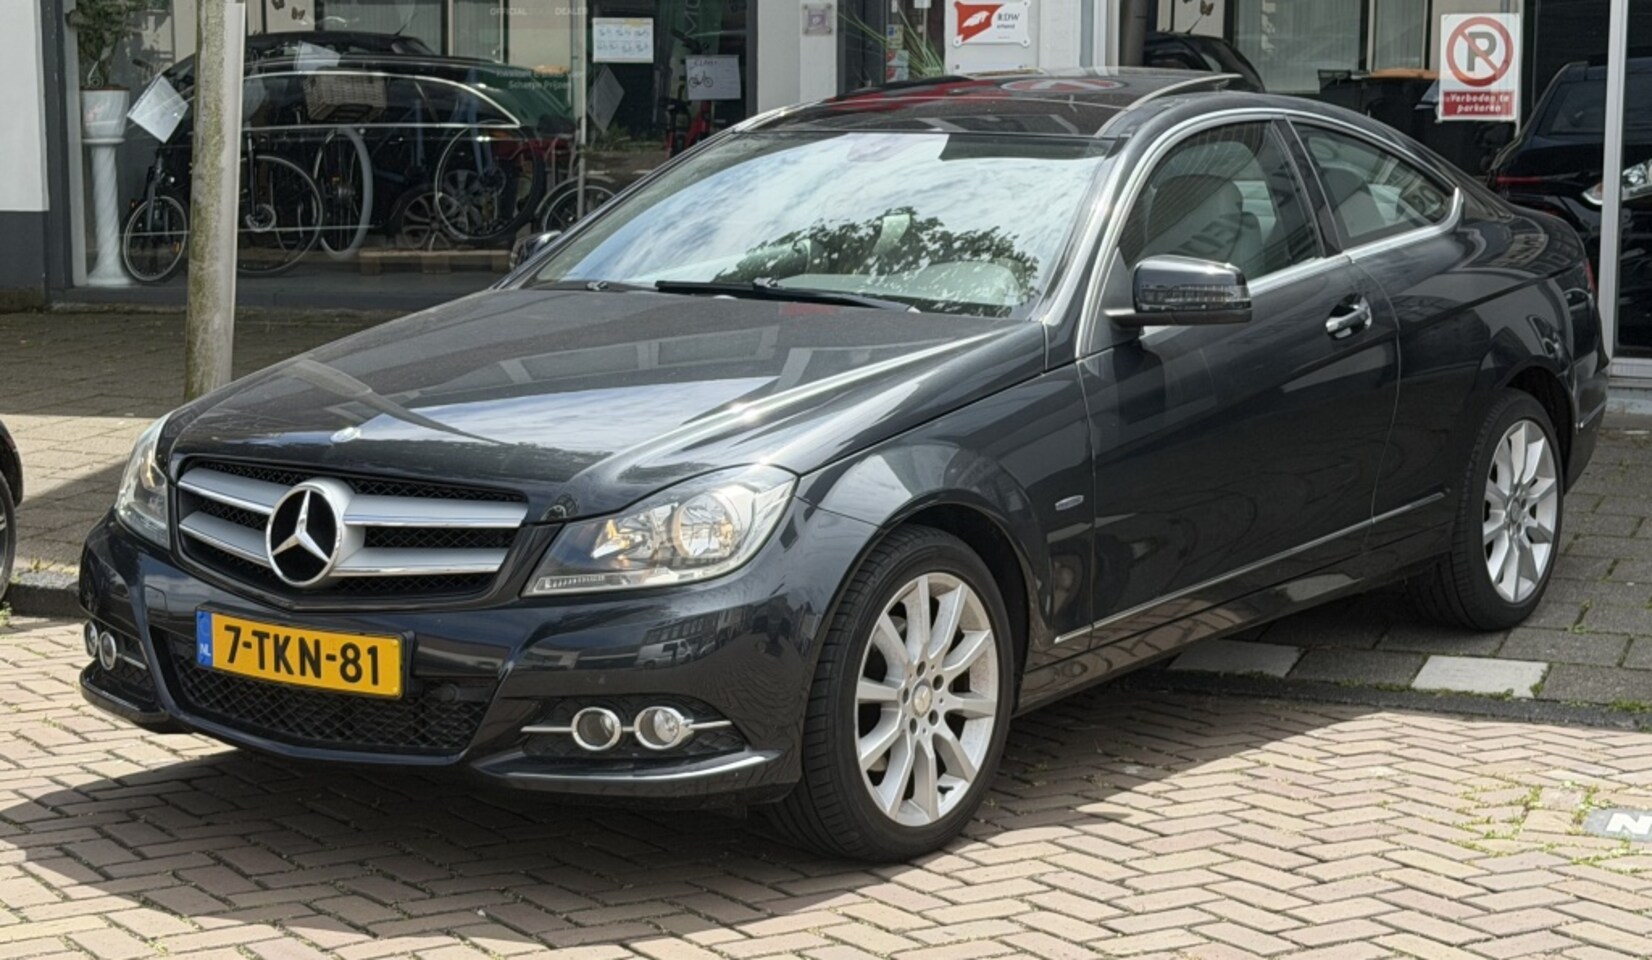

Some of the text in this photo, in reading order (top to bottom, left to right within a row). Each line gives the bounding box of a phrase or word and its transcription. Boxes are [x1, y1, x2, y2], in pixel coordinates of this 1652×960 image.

[1449, 93, 1511, 103] Verboden te
[1456, 102, 1502, 114] parkeren
[199, 624, 380, 686] NL 7-TKN-81
